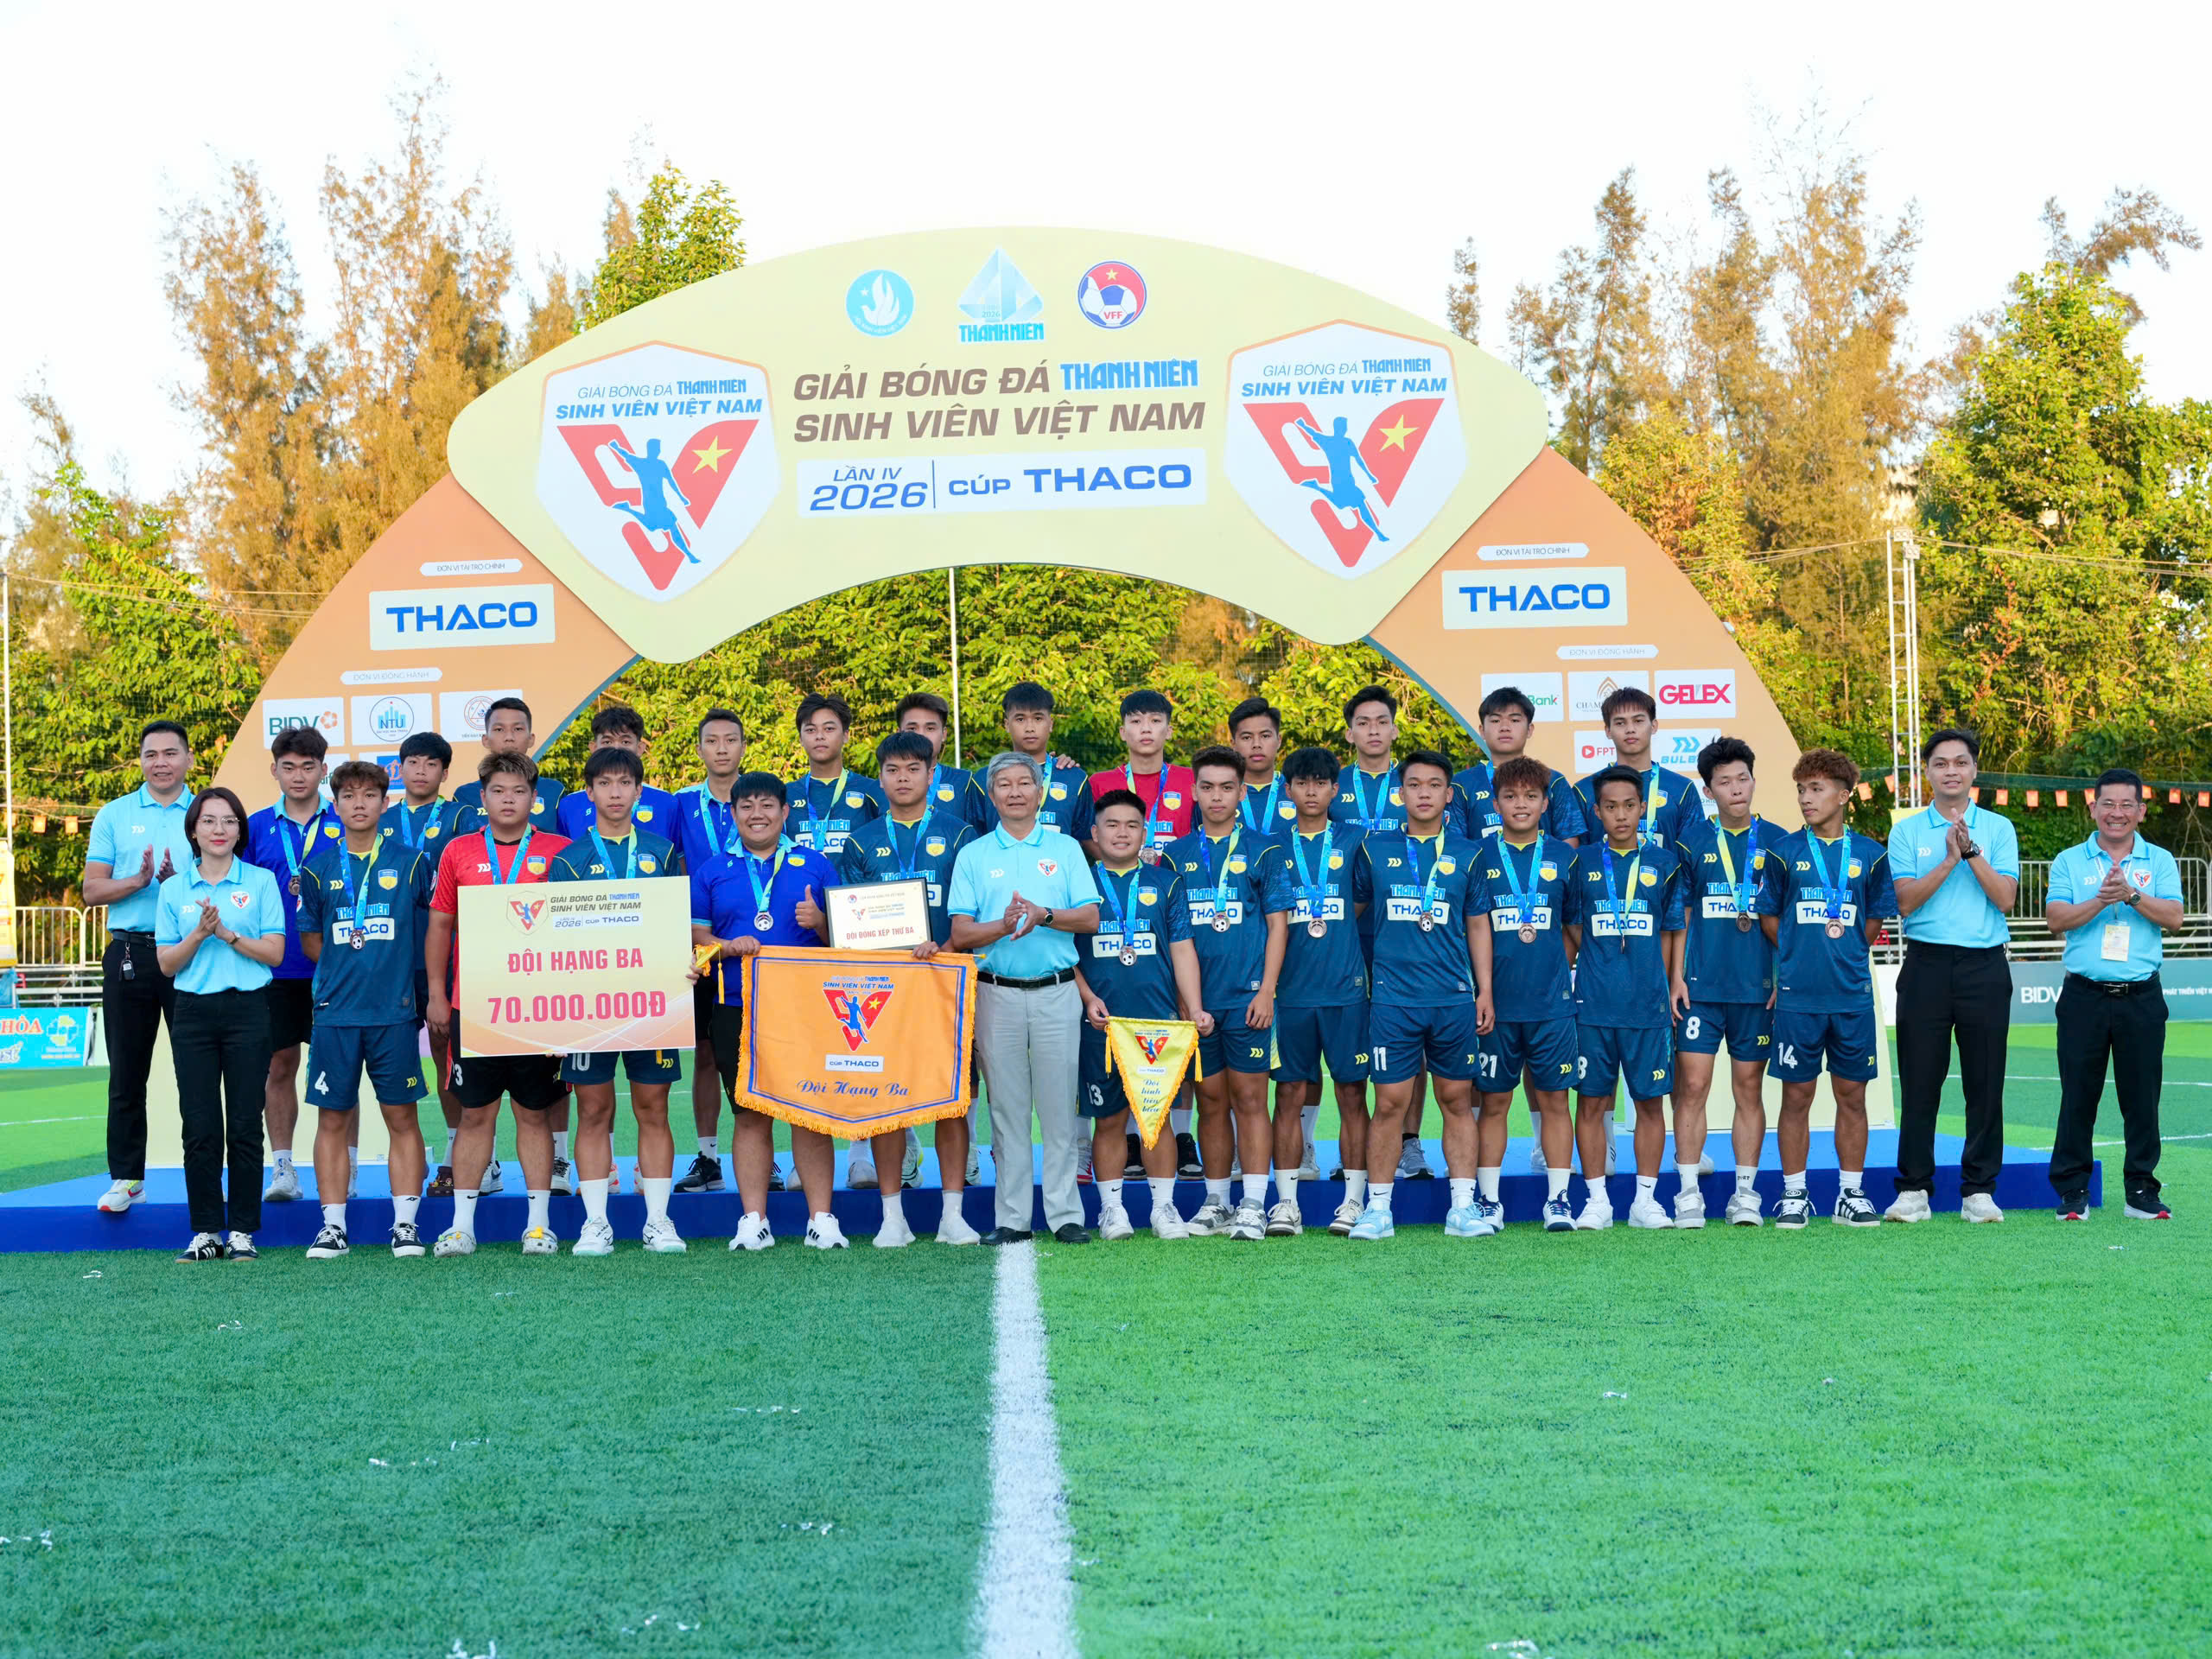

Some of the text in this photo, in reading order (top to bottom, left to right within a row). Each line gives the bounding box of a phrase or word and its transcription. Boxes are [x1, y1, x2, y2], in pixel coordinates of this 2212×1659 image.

[1103, 311, 1123, 321] VFF
[793, 364, 868, 401] GIẢI
[879, 363, 988, 398] BÓNG
[998, 359, 1051, 394] ĐÁ
[1242, 376, 1447, 397] SINH VIÊN VIỆT NAM
[608, 384, 650, 397] BÓNG
[556, 397, 762, 420] SINH VIÊN VIỆT NAM
[793, 399, 1206, 442] SINH VIÊN VIỆT NAM
[833, 465, 903, 482] LẦN IV
[1023, 464, 1192, 494] THACO
[948, 474, 1012, 496] CÚP
[809, 481, 928, 512] 2026
[1459, 583, 1611, 613] THACO
[386, 601, 537, 632] THACO
[1659, 683, 1732, 705] GELEX
[270, 715, 320, 735] BIDV
[380, 718, 404, 729] NTU
[1597, 747, 1616, 756] FPT
[1661, 755, 1697, 764] BULB
[575, 903, 596, 912] VIÊN
[599, 902, 618, 912] VIỆT
[1190, 908, 1238, 919] THAO
[1293, 904, 1339, 918] THCO
[1392, 904, 1444, 918] THAO
[1709, 901, 1758, 913] THAO
[1803, 906, 1850, 920] THAO
[602, 915, 639, 924] THACO
[1098, 939, 1152, 951] THCO
[508, 948, 644, 976] ĐỘI HẠNG BA
[2020, 987, 2063, 1004] BIDV
[487, 990, 666, 1025] 70.000.000Đ
[1685, 1015, 1701, 1040] 8
[571, 1052, 591, 1071] 10
[844, 1059, 880, 1068] THACO
[1373, 1046, 1388, 1071] 11
[1478, 1052, 1498, 1079] 21
[1777, 1042, 1798, 1070] 14
[314, 1070, 330, 1096] 4
[797, 1079, 909, 1097] Đội Hạng Ba
